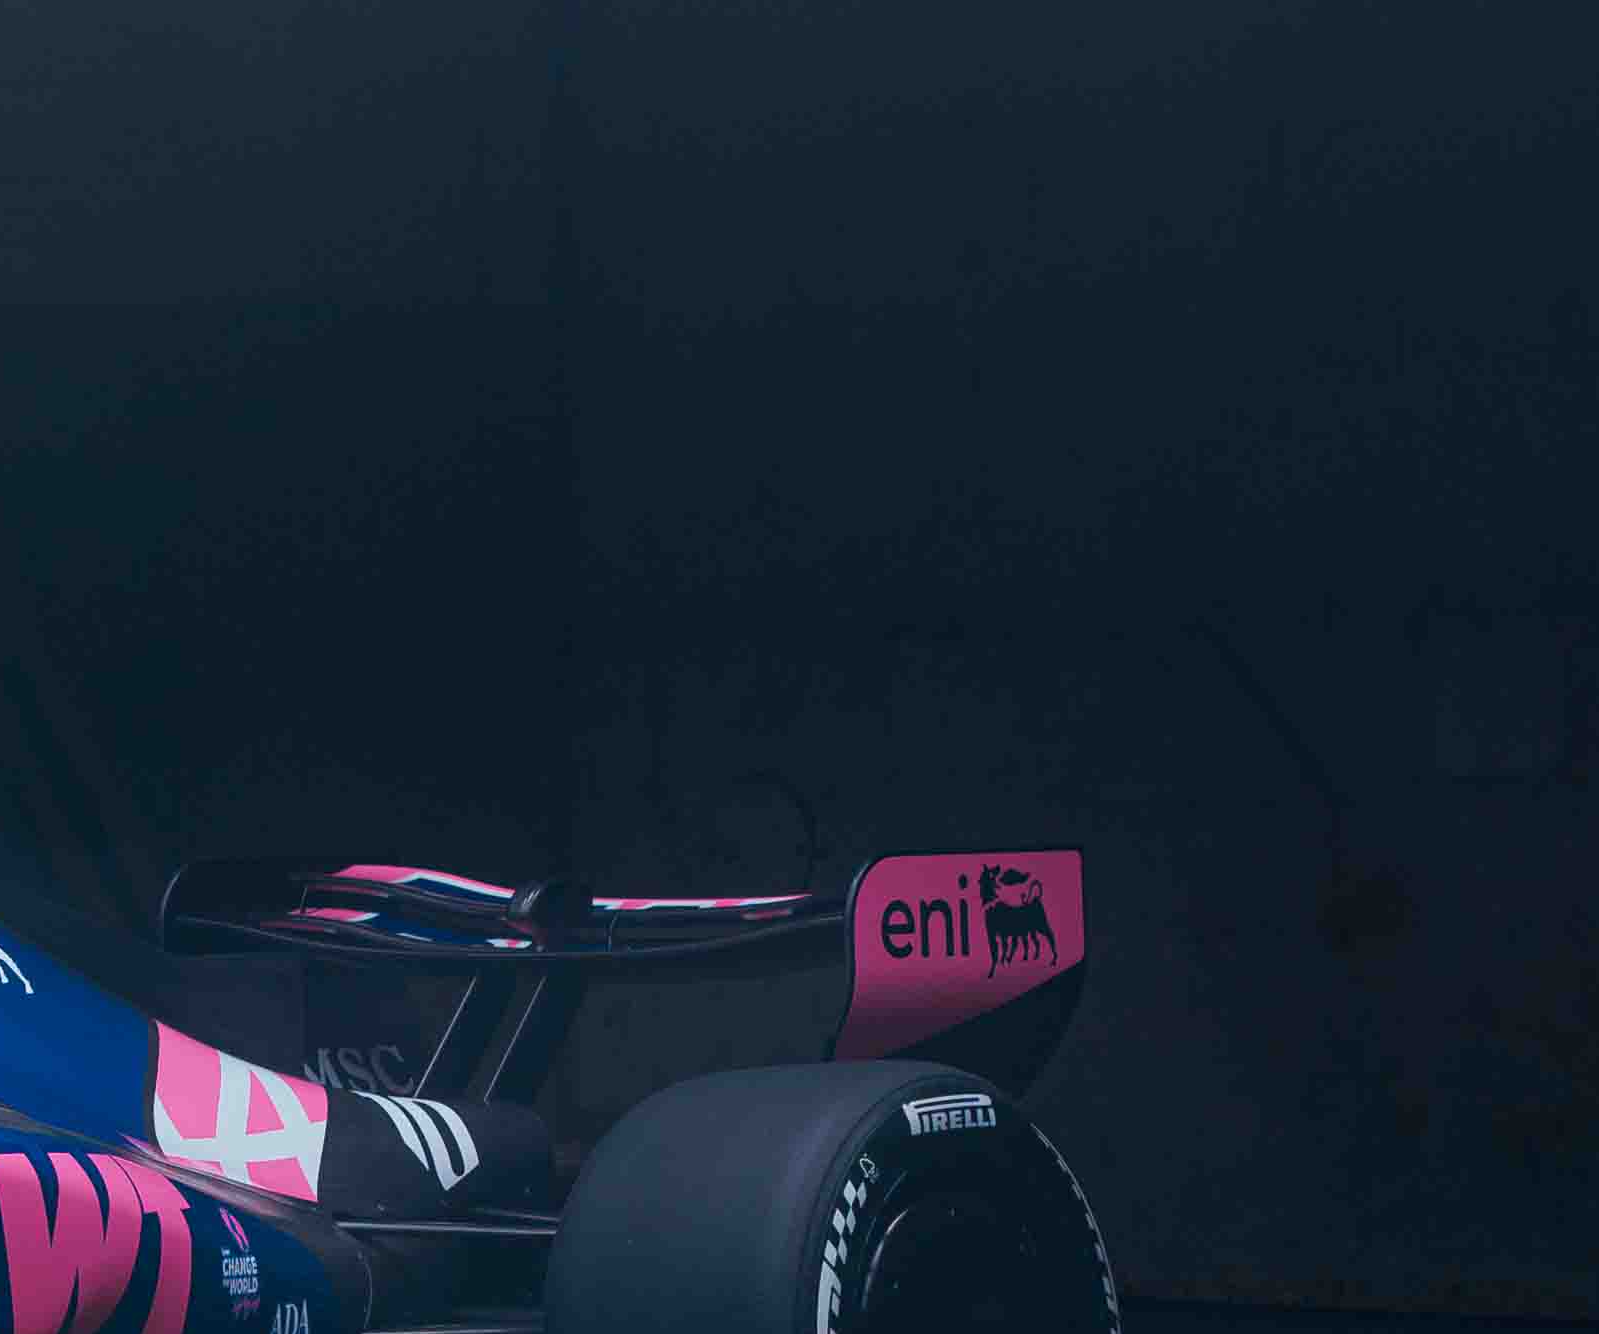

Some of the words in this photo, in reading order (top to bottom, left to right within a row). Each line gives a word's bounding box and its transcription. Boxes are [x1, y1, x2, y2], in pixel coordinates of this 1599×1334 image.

[881, 874, 970, 959] eni
[901, 1092, 997, 1137] PIRELLI
[222, 1256, 258, 1277] CHANGE
